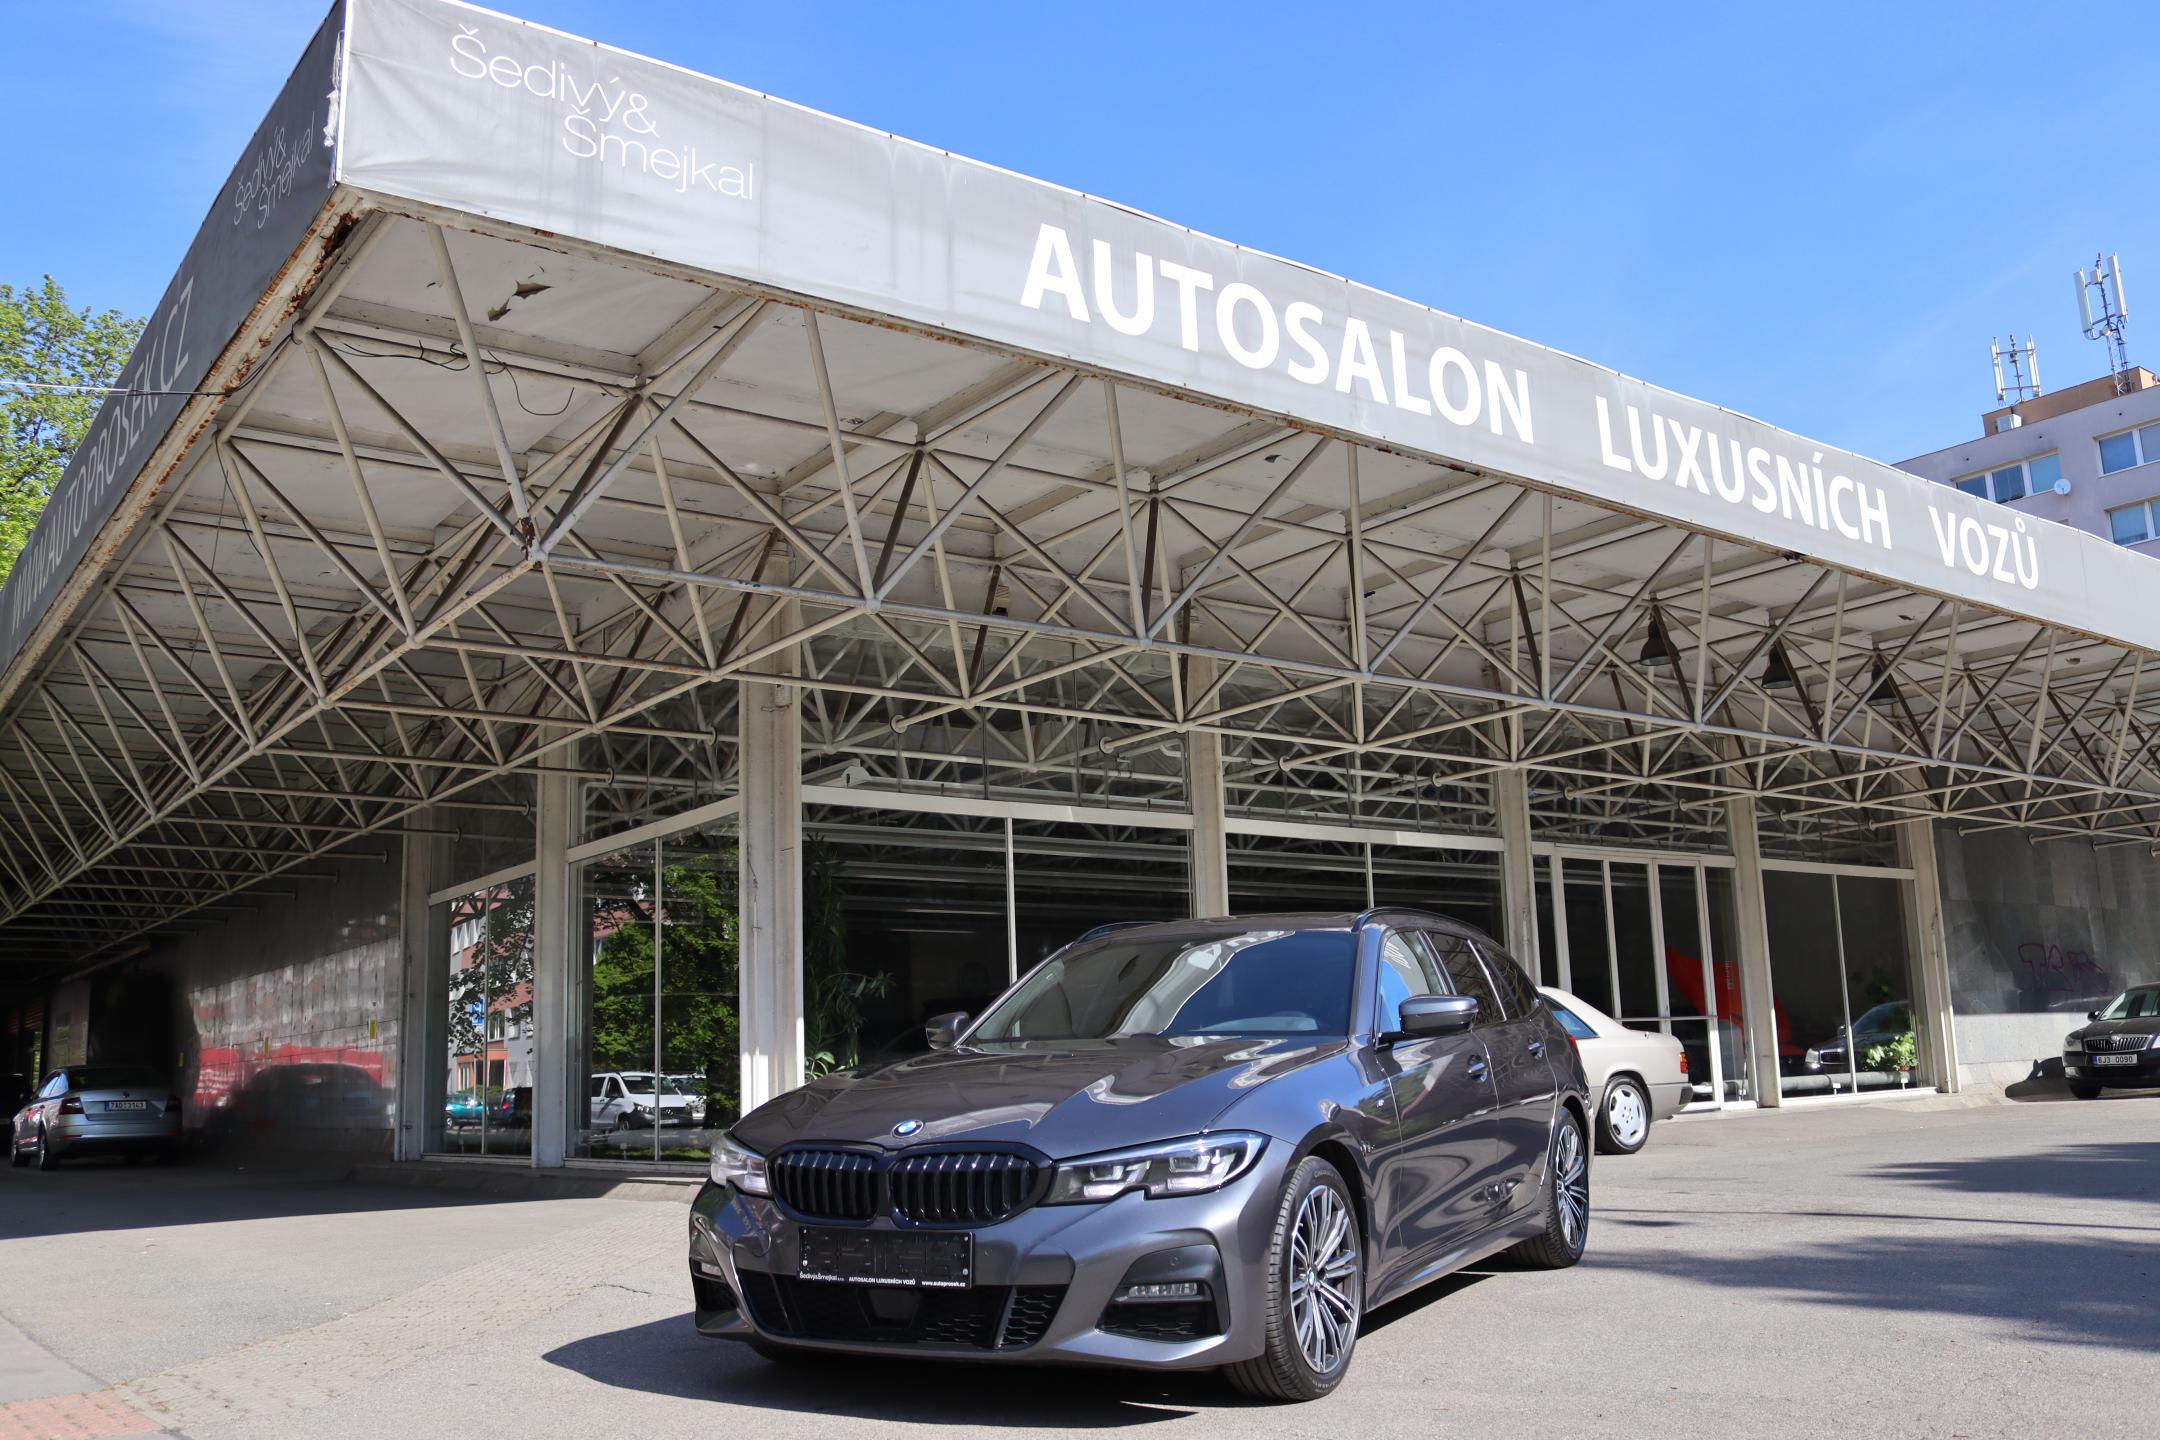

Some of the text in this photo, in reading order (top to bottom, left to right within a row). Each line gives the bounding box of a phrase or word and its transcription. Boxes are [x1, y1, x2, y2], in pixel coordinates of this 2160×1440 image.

[449, 23, 661, 138] Šedivý&
[257, 111, 315, 229] Šmejkal
[562, 103, 754, 200] Šmejkal
[11, 275, 194, 635] WWW.AUTOPROSEK.CZ
[1020, 223, 2039, 590] AUTOSALON LUXUSNÍCH VOZŮ
[903, 1278, 916, 1286] VOZŮ
